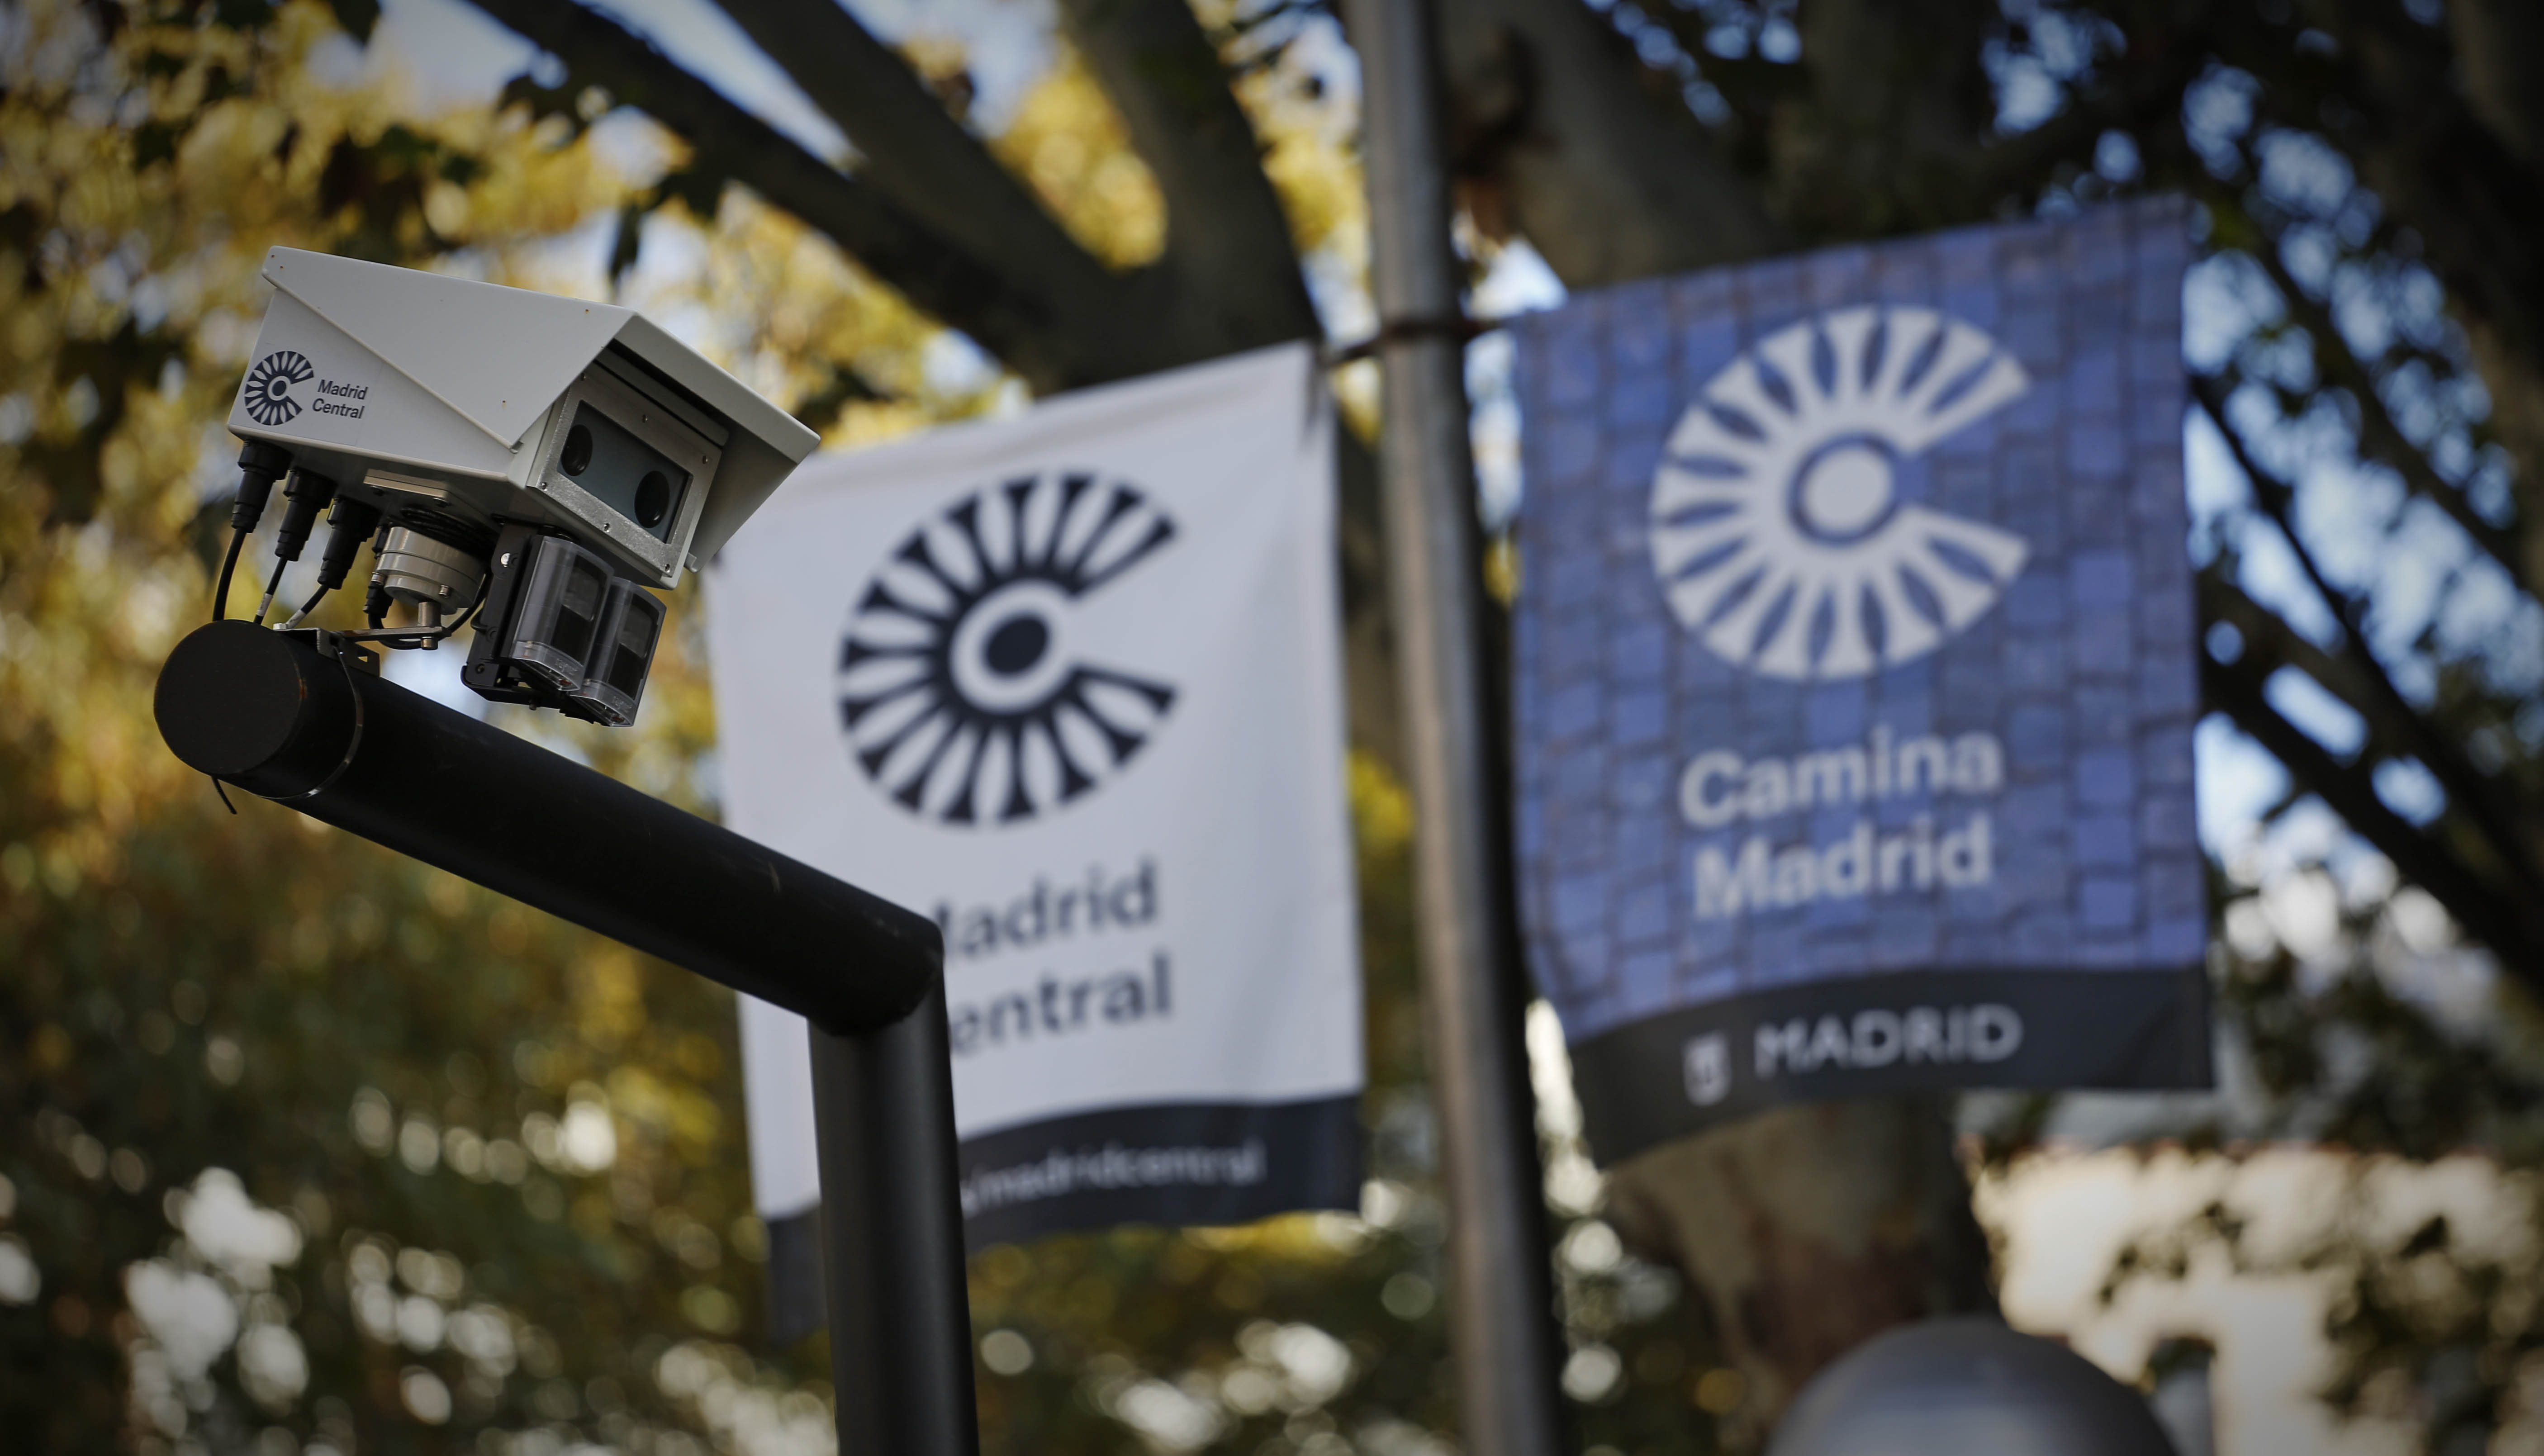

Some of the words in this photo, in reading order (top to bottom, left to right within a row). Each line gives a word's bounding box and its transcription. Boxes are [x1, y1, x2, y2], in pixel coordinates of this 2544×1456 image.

[312, 398, 365, 419] Central
[317, 379, 368, 400] Madrid
[1679, 725, 2003, 828] Camina
[1694, 814, 1991, 919] Madrid
[949, 950, 1171, 1054] entral
[1754, 1002, 2024, 1080] MADRID
